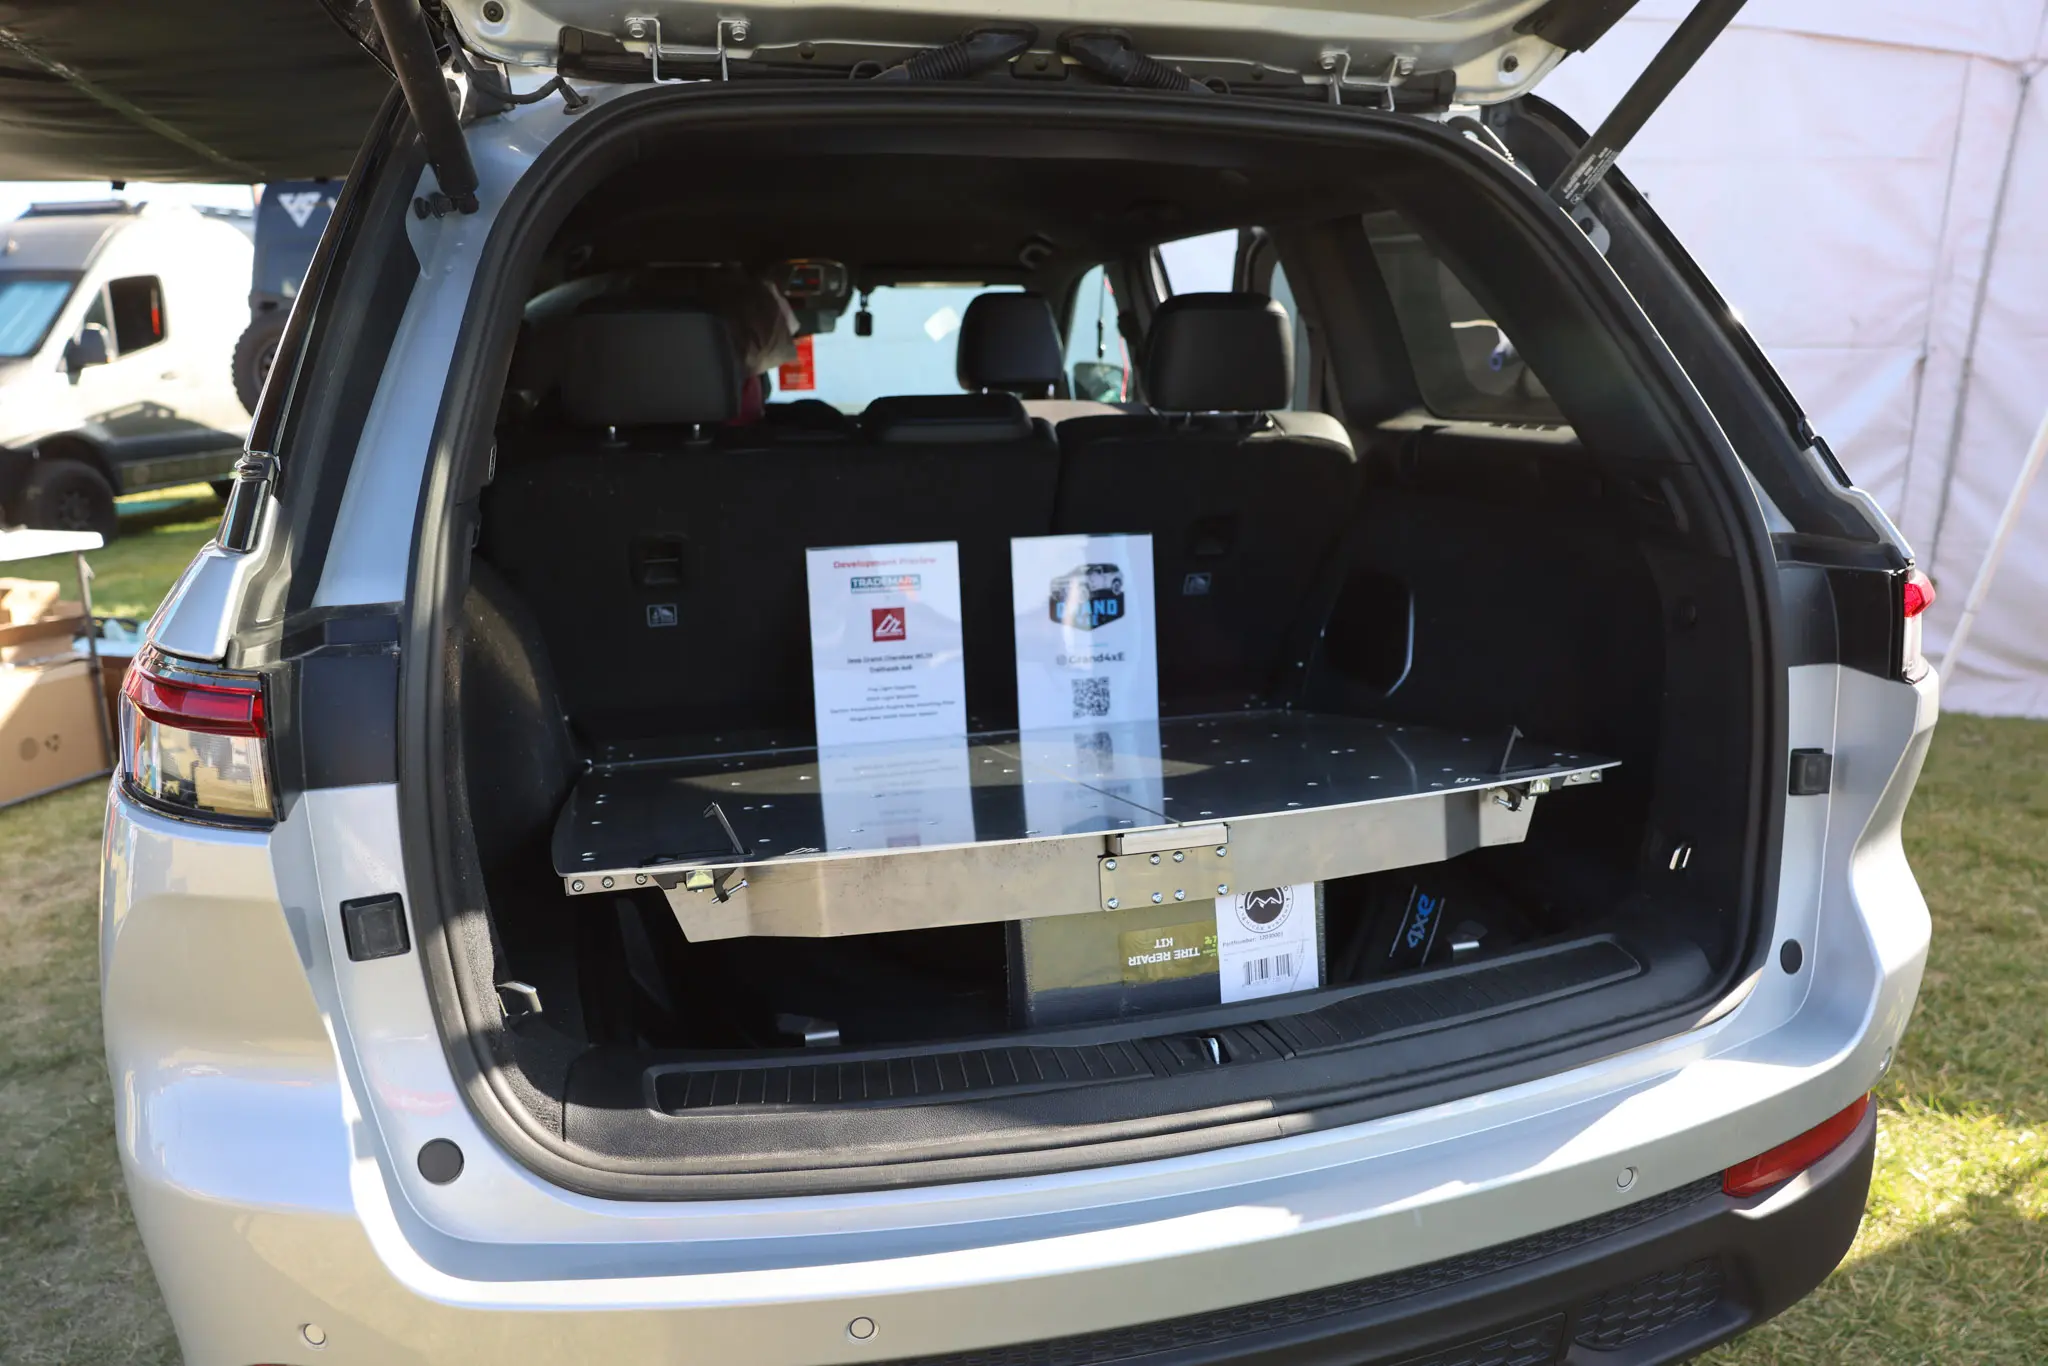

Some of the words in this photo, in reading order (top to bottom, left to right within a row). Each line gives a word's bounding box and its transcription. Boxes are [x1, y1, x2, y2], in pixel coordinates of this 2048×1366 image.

[1154, 937, 1174, 949] KIT
[1128, 951, 1171, 967] REPAIR
[1173, 947, 1201, 960] TIRE
